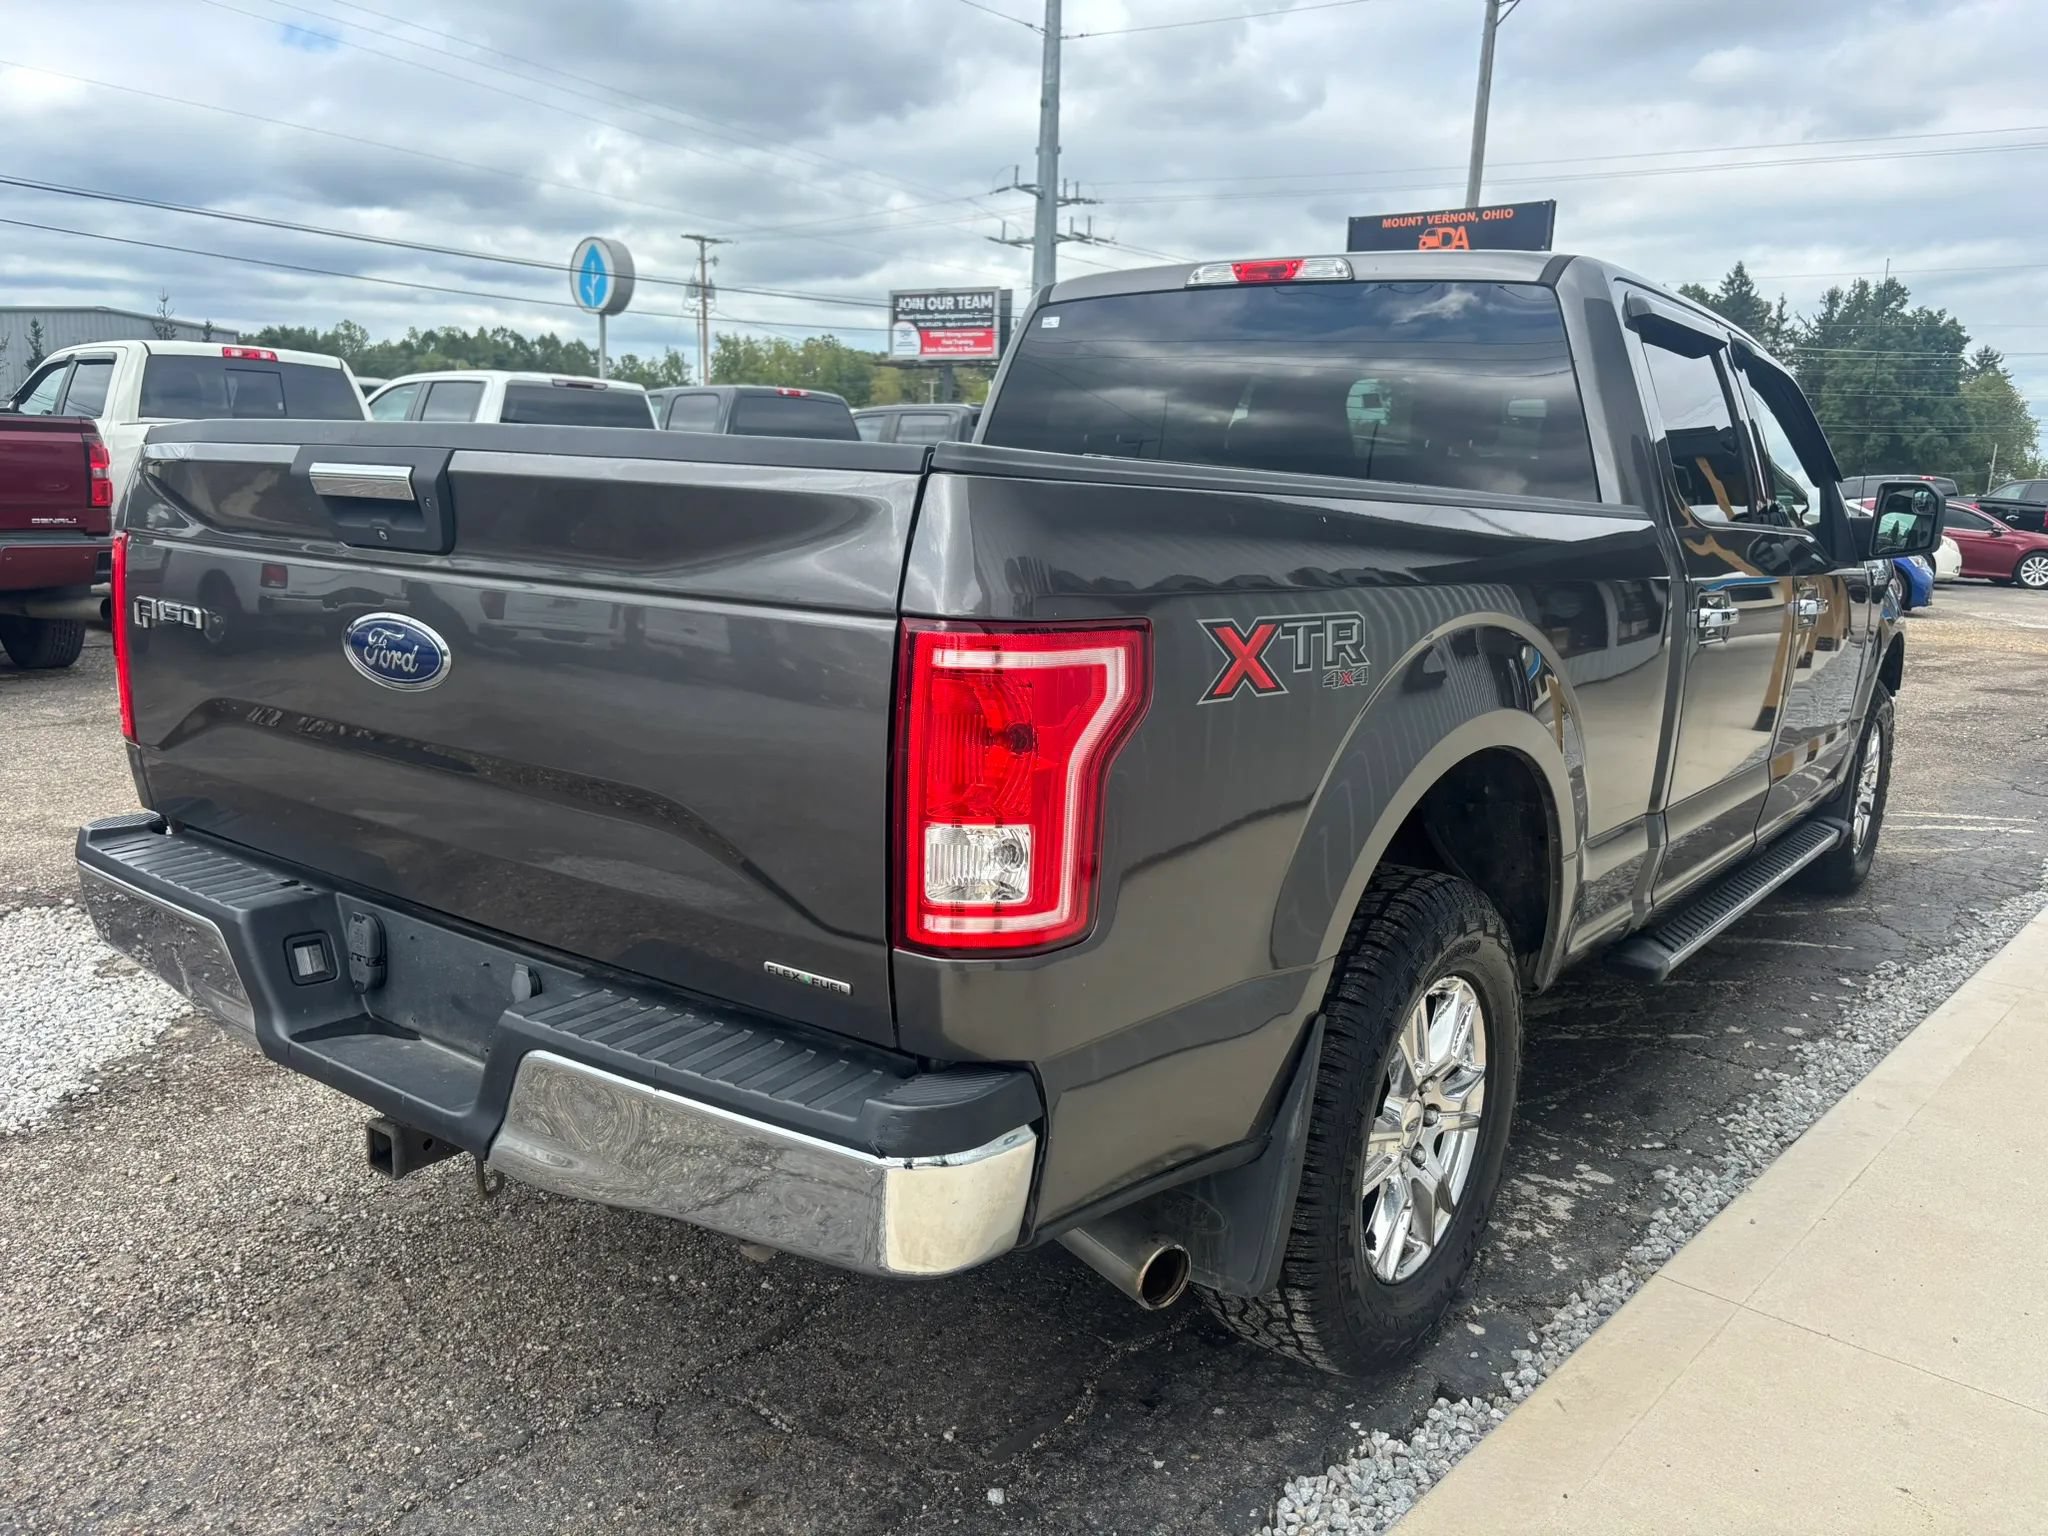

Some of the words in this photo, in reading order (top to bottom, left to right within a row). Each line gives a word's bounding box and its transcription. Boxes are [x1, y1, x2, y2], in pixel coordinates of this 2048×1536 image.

[1382, 216, 1424, 228] MOUNT
[1427, 211, 1479, 225] VERNON,
[1482, 208, 1514, 220] OHIO
[896, 297, 925, 311] JOIN
[927, 296, 955, 310] OUR
[957, 295, 993, 309] TEAM
[364, 627, 419, 673] Ford
[1196, 611, 1372, 705] XTR
[767, 965, 800, 981] FLEX
[811, 977, 848, 993] FUEL
